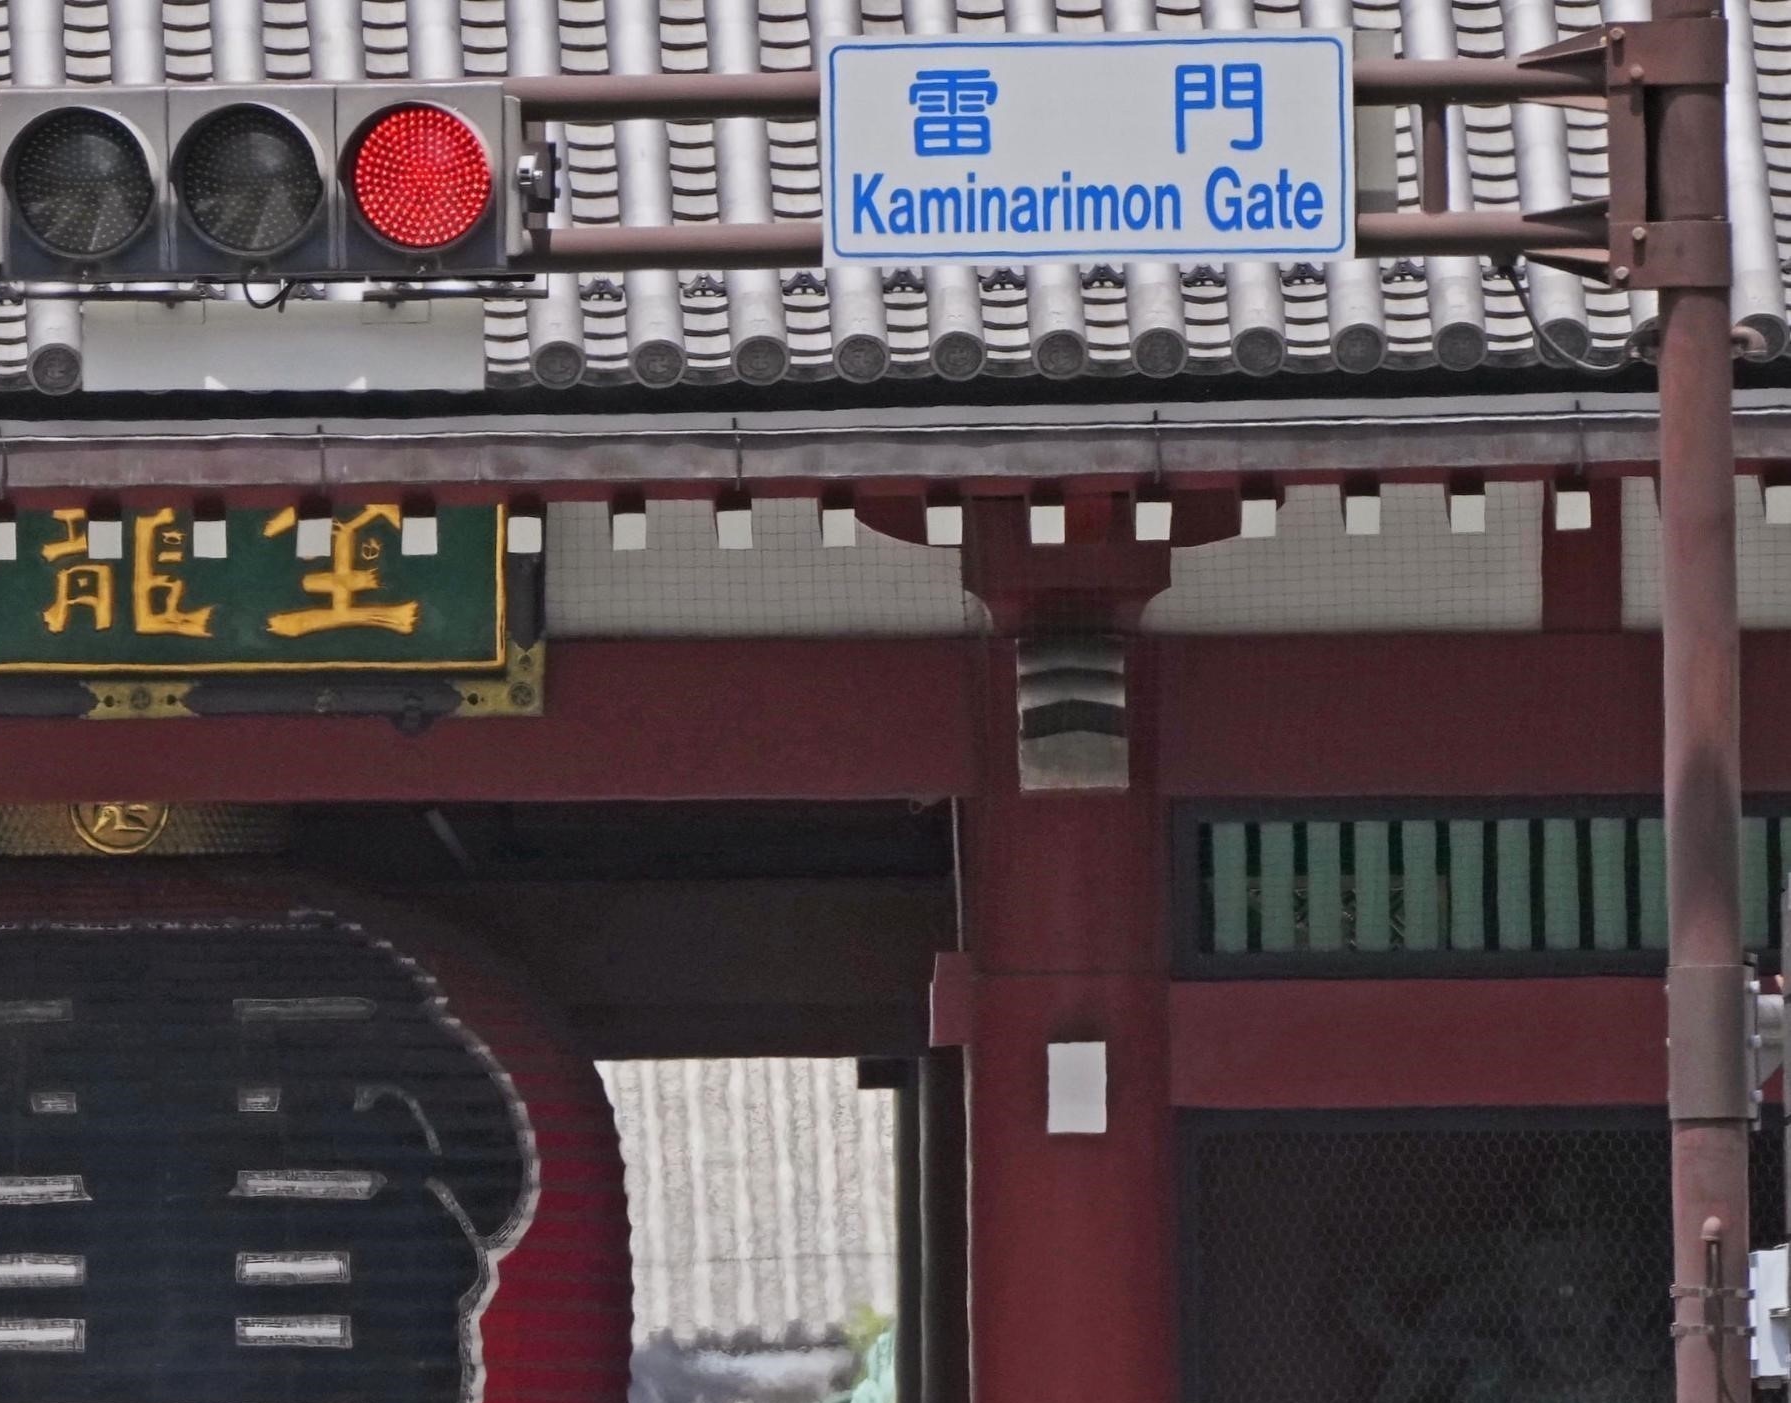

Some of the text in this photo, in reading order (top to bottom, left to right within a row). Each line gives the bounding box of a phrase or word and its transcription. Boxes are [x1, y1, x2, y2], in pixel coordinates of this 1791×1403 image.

[908, 62, 1264, 157] 雷門
[852, 166, 1324, 235] Kaminarimon Gate
